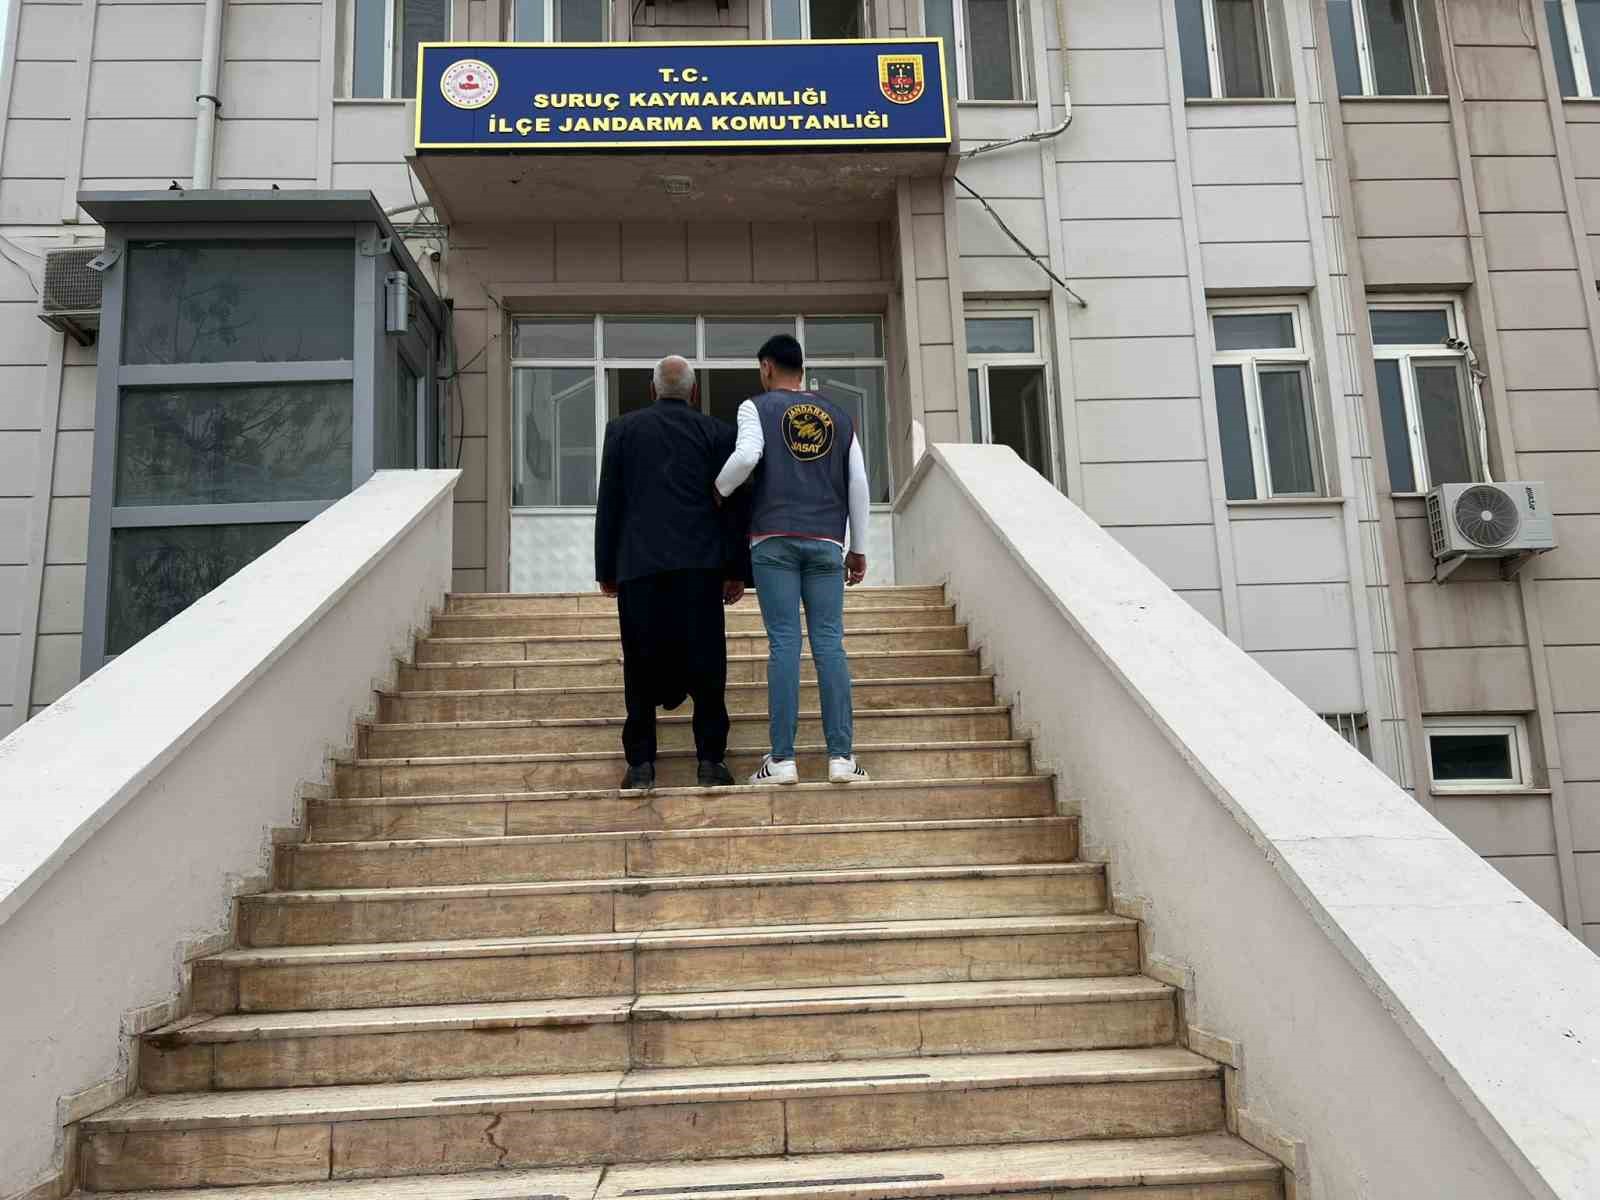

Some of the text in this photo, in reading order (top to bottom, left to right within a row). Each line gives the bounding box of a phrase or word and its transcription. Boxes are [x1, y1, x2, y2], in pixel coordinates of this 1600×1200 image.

[658, 68, 709, 83] T.C.
[533, 87, 828, 111] SURUÇ KAYMAKAMLIĞI
[488, 110, 890, 136] İLÇE JANDARMA KOMUTANLIĞI
